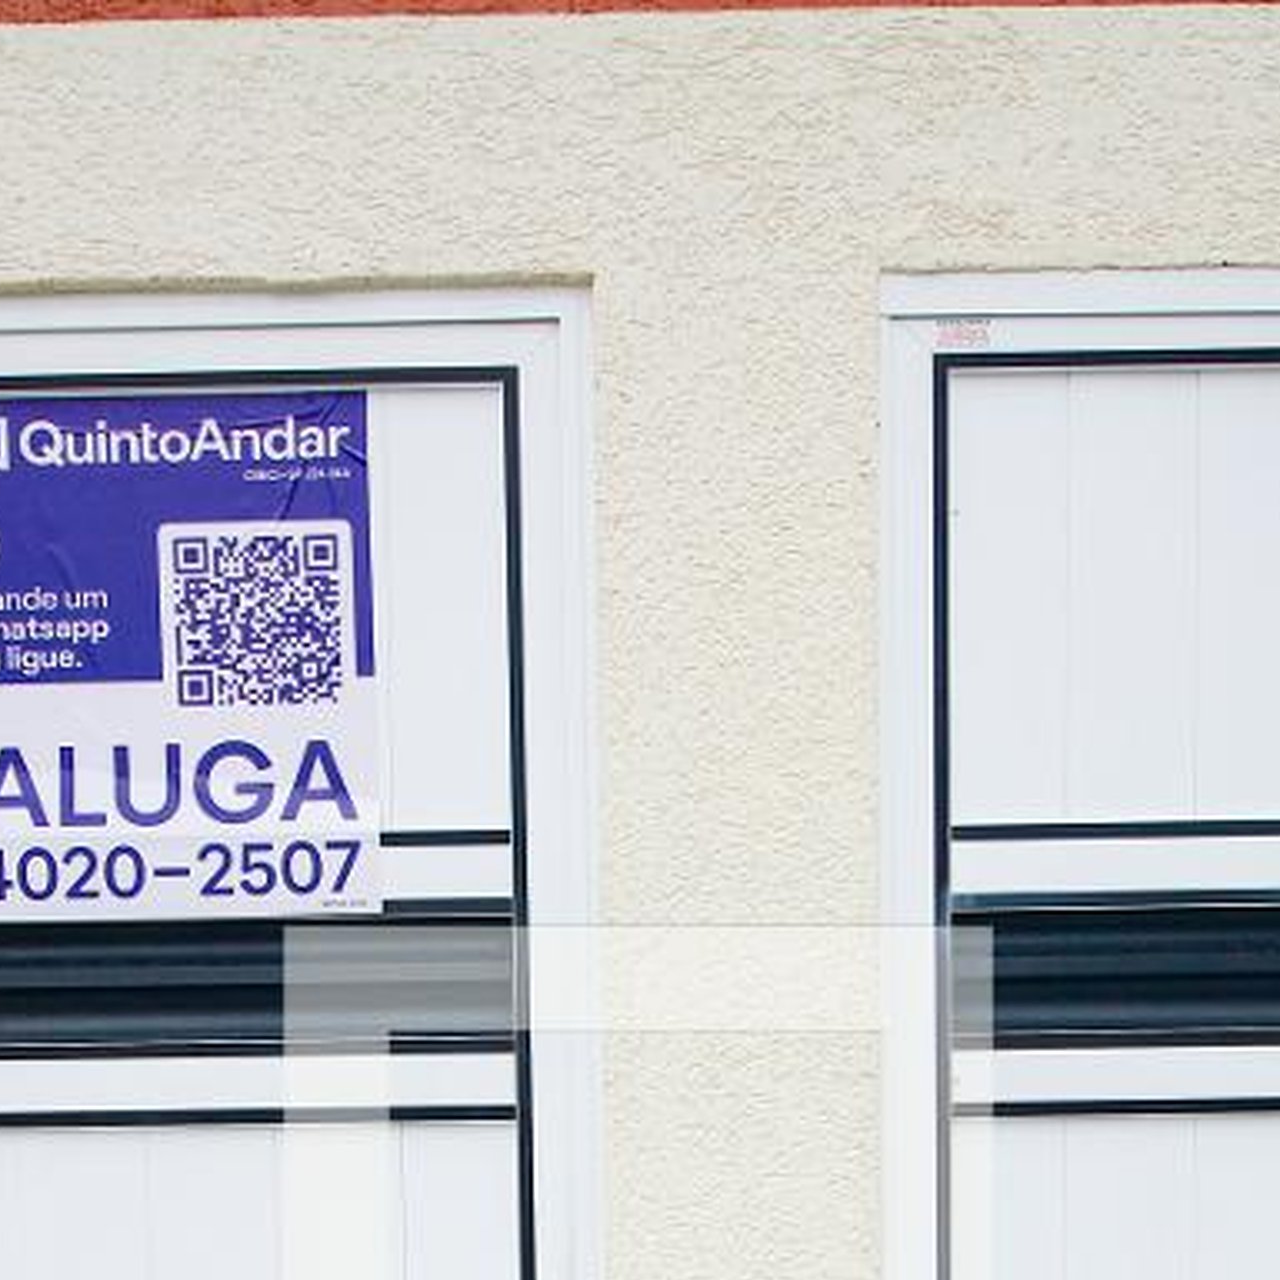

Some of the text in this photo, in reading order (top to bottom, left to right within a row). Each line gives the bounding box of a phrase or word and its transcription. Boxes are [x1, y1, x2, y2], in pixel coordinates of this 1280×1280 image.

[19, 415, 351, 466] QuintoAndar
[65, 589, 108, 608] um
[6, 646, 83, 676] ligue.
